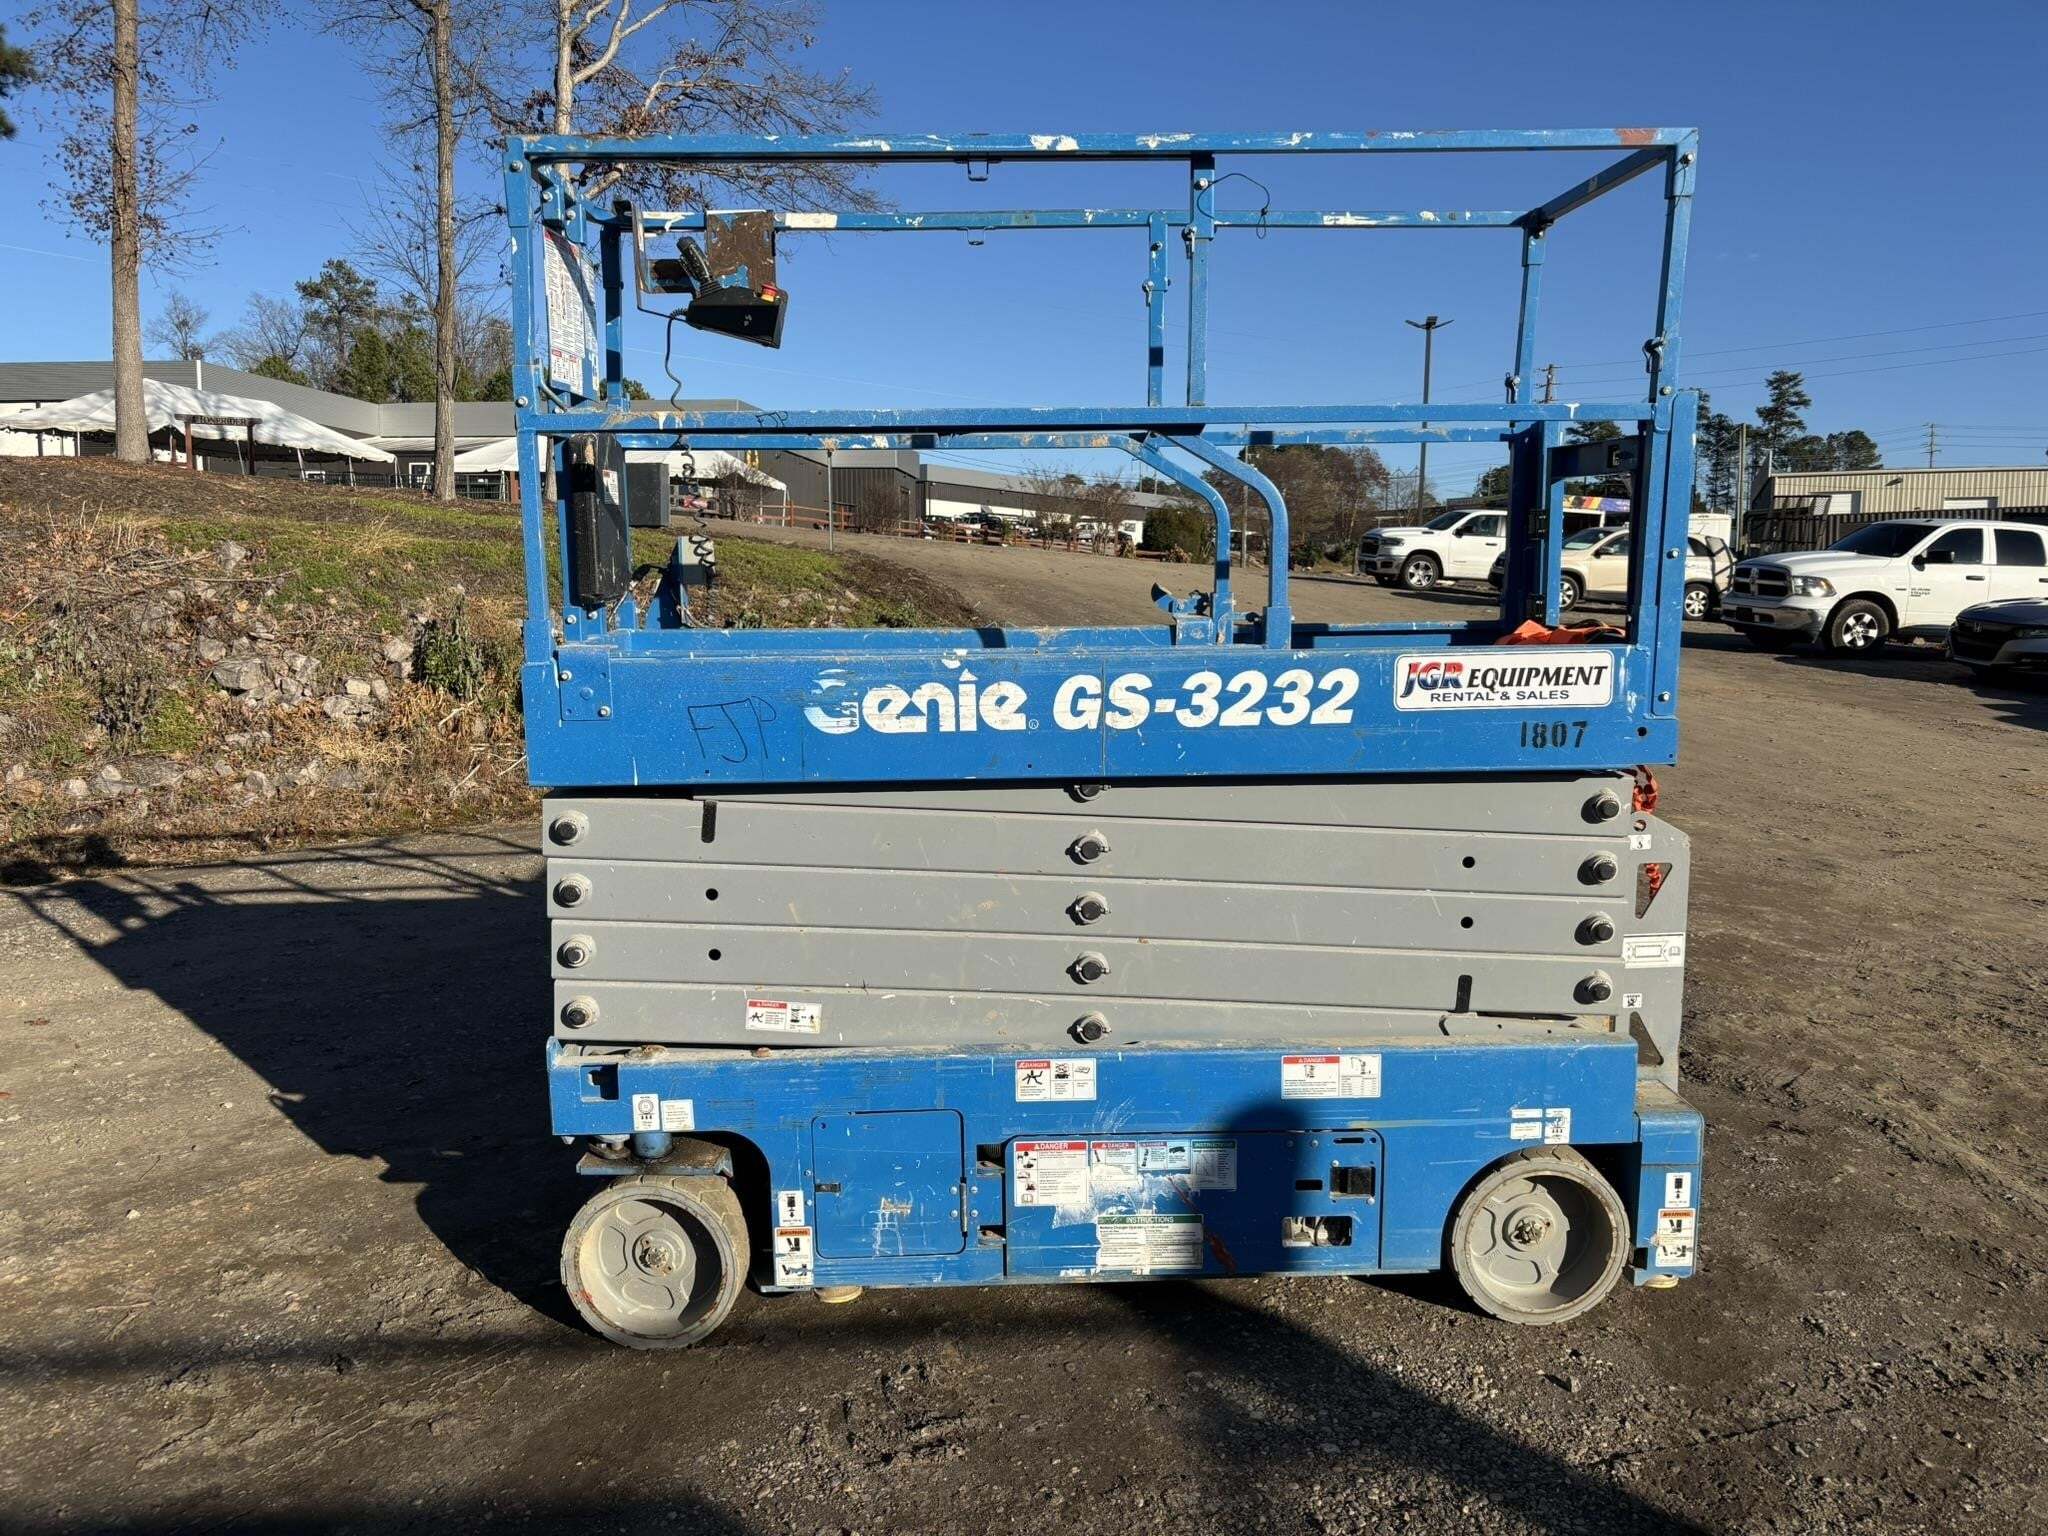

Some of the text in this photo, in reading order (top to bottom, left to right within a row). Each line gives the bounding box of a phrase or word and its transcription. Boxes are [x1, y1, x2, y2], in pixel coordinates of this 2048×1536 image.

[1400, 661, 1608, 698] JGR EQUIPMENT
[1052, 667, 1360, 731] GS-3232
[1430, 689, 1570, 702] RENTAL & SALES
[1519, 720, 1588, 749] 1807
[1040, 1142, 1069, 1150] DANGER
